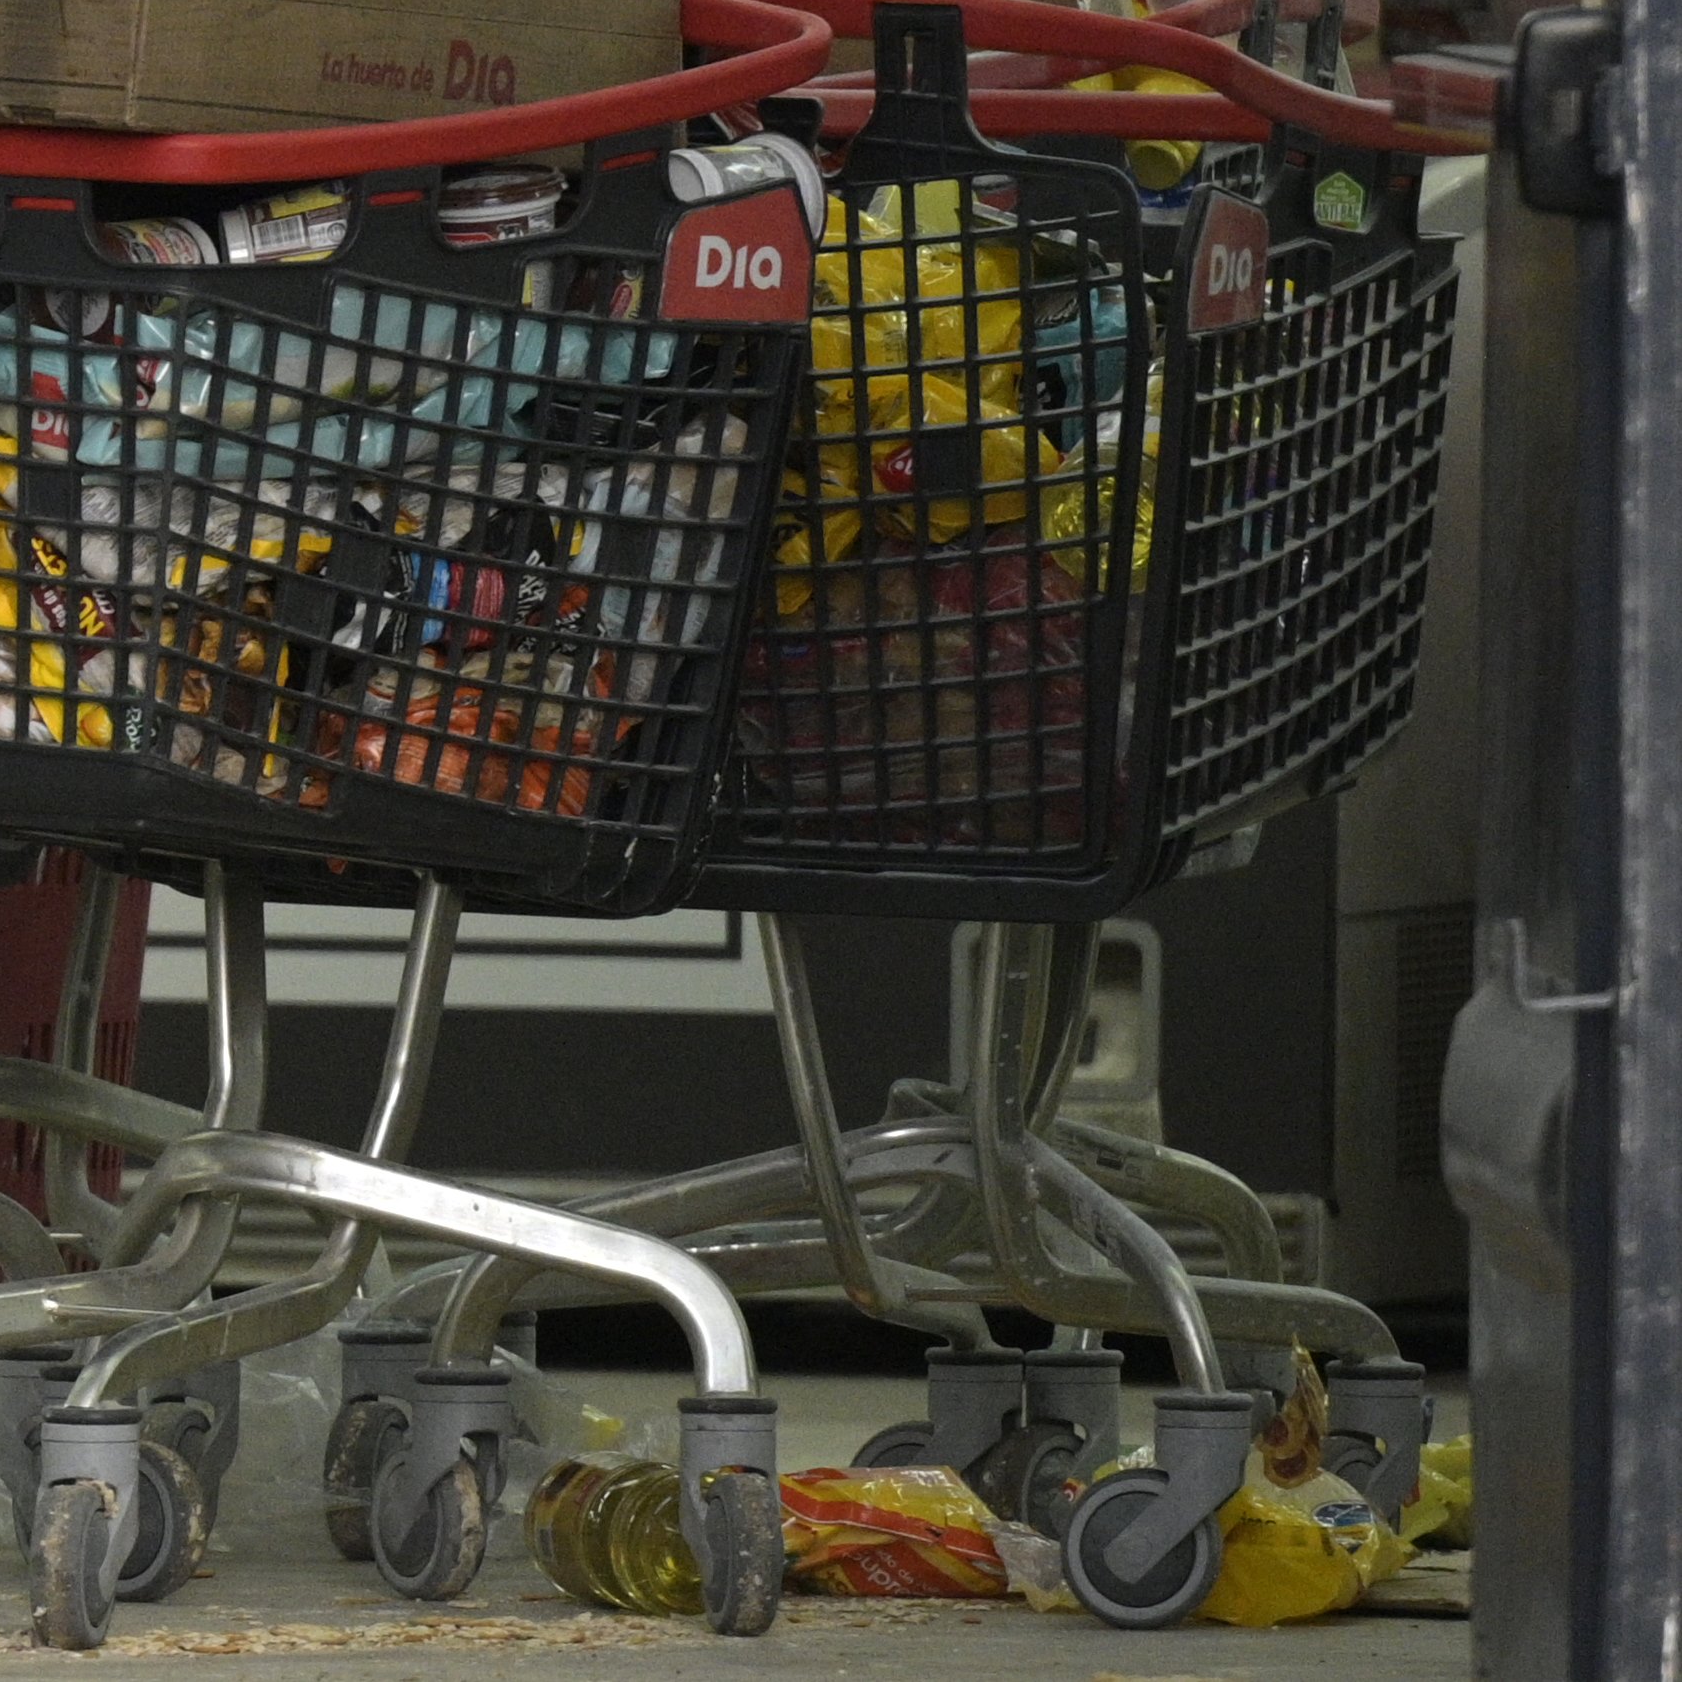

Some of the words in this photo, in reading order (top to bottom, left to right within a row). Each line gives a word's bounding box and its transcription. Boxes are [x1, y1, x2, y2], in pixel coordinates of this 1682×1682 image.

[320, 52, 344, 83] La
[347, 53, 406, 90] huerta
[410, 60, 435, 92] de
[443, 38, 517, 105] Dia
[695, 235, 783, 290] Dia
[1208, 244, 1253, 297] Dia
